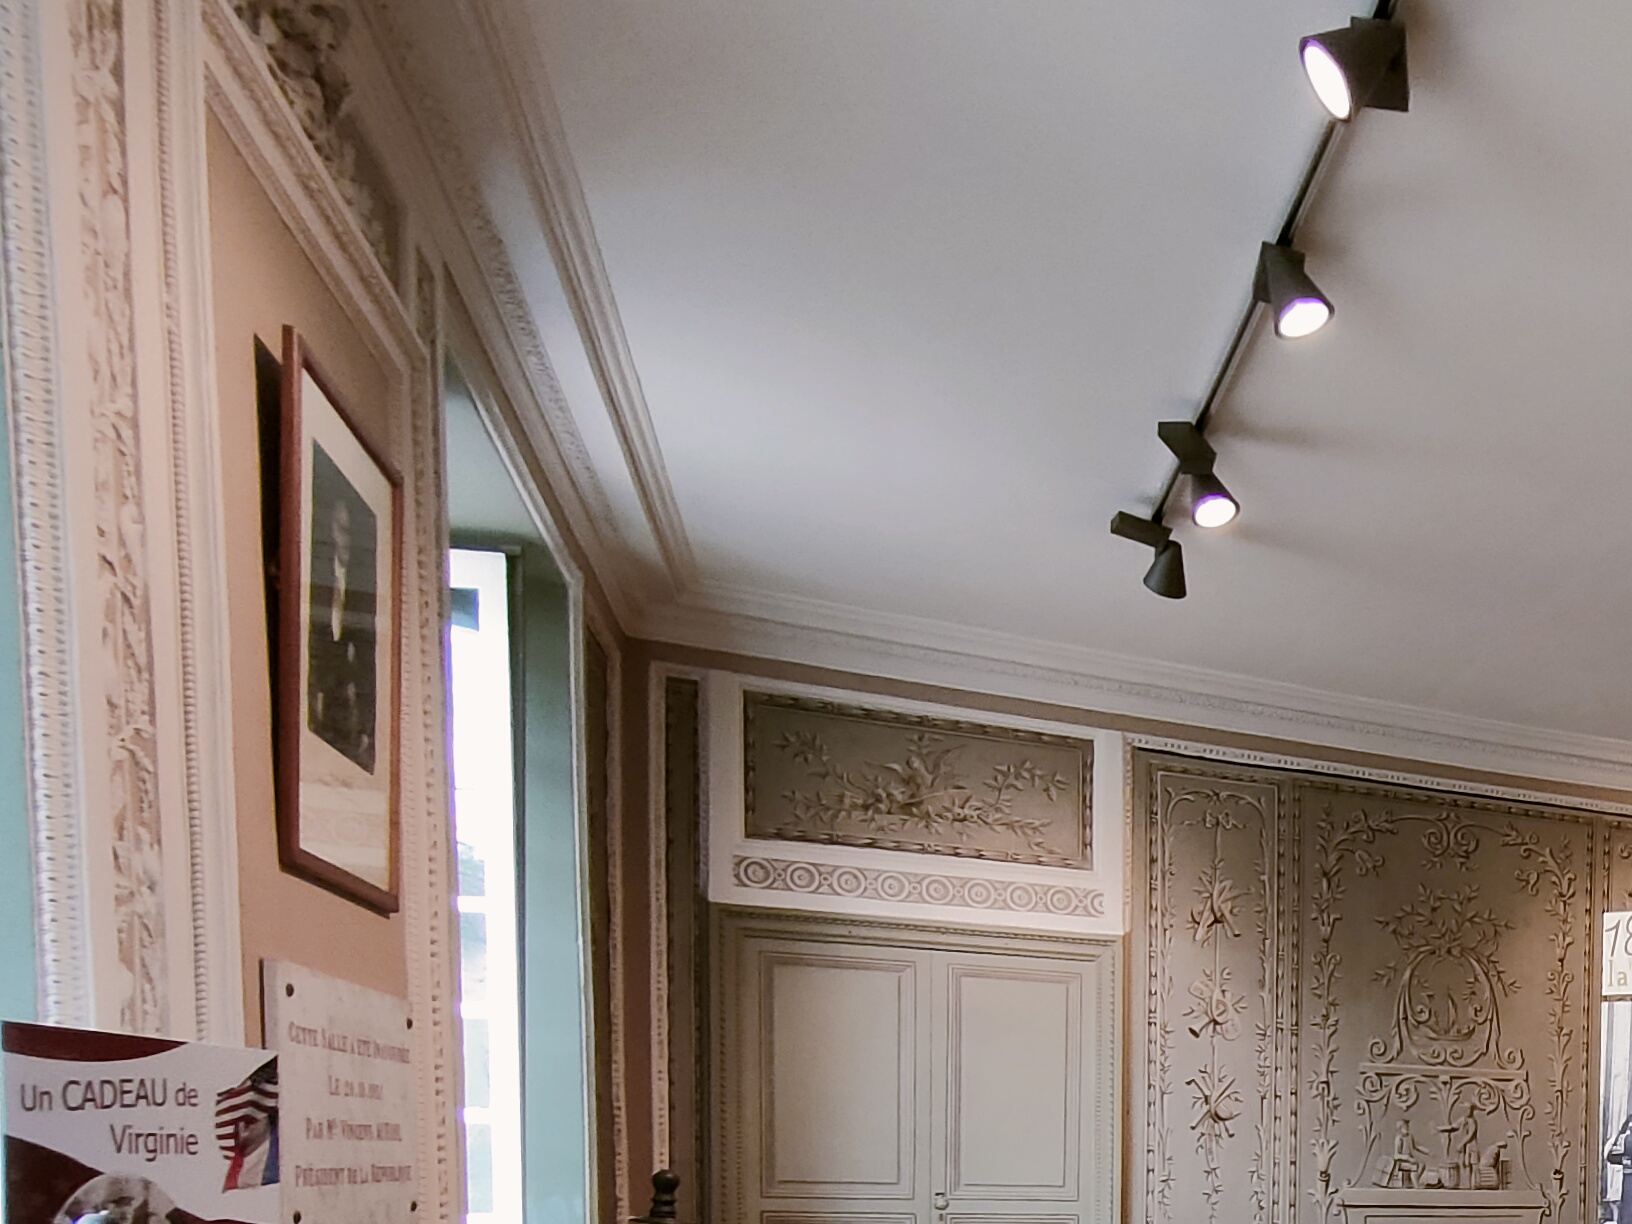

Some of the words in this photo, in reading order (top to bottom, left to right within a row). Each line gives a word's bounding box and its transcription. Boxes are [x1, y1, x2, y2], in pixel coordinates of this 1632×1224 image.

[1608, 960, 1628, 987] la
[20, 1084, 52, 1112] Un
[62, 1078, 168, 1111] CADEAU
[174, 1082, 199, 1107] de
[110, 1124, 199, 1163] Virginie
